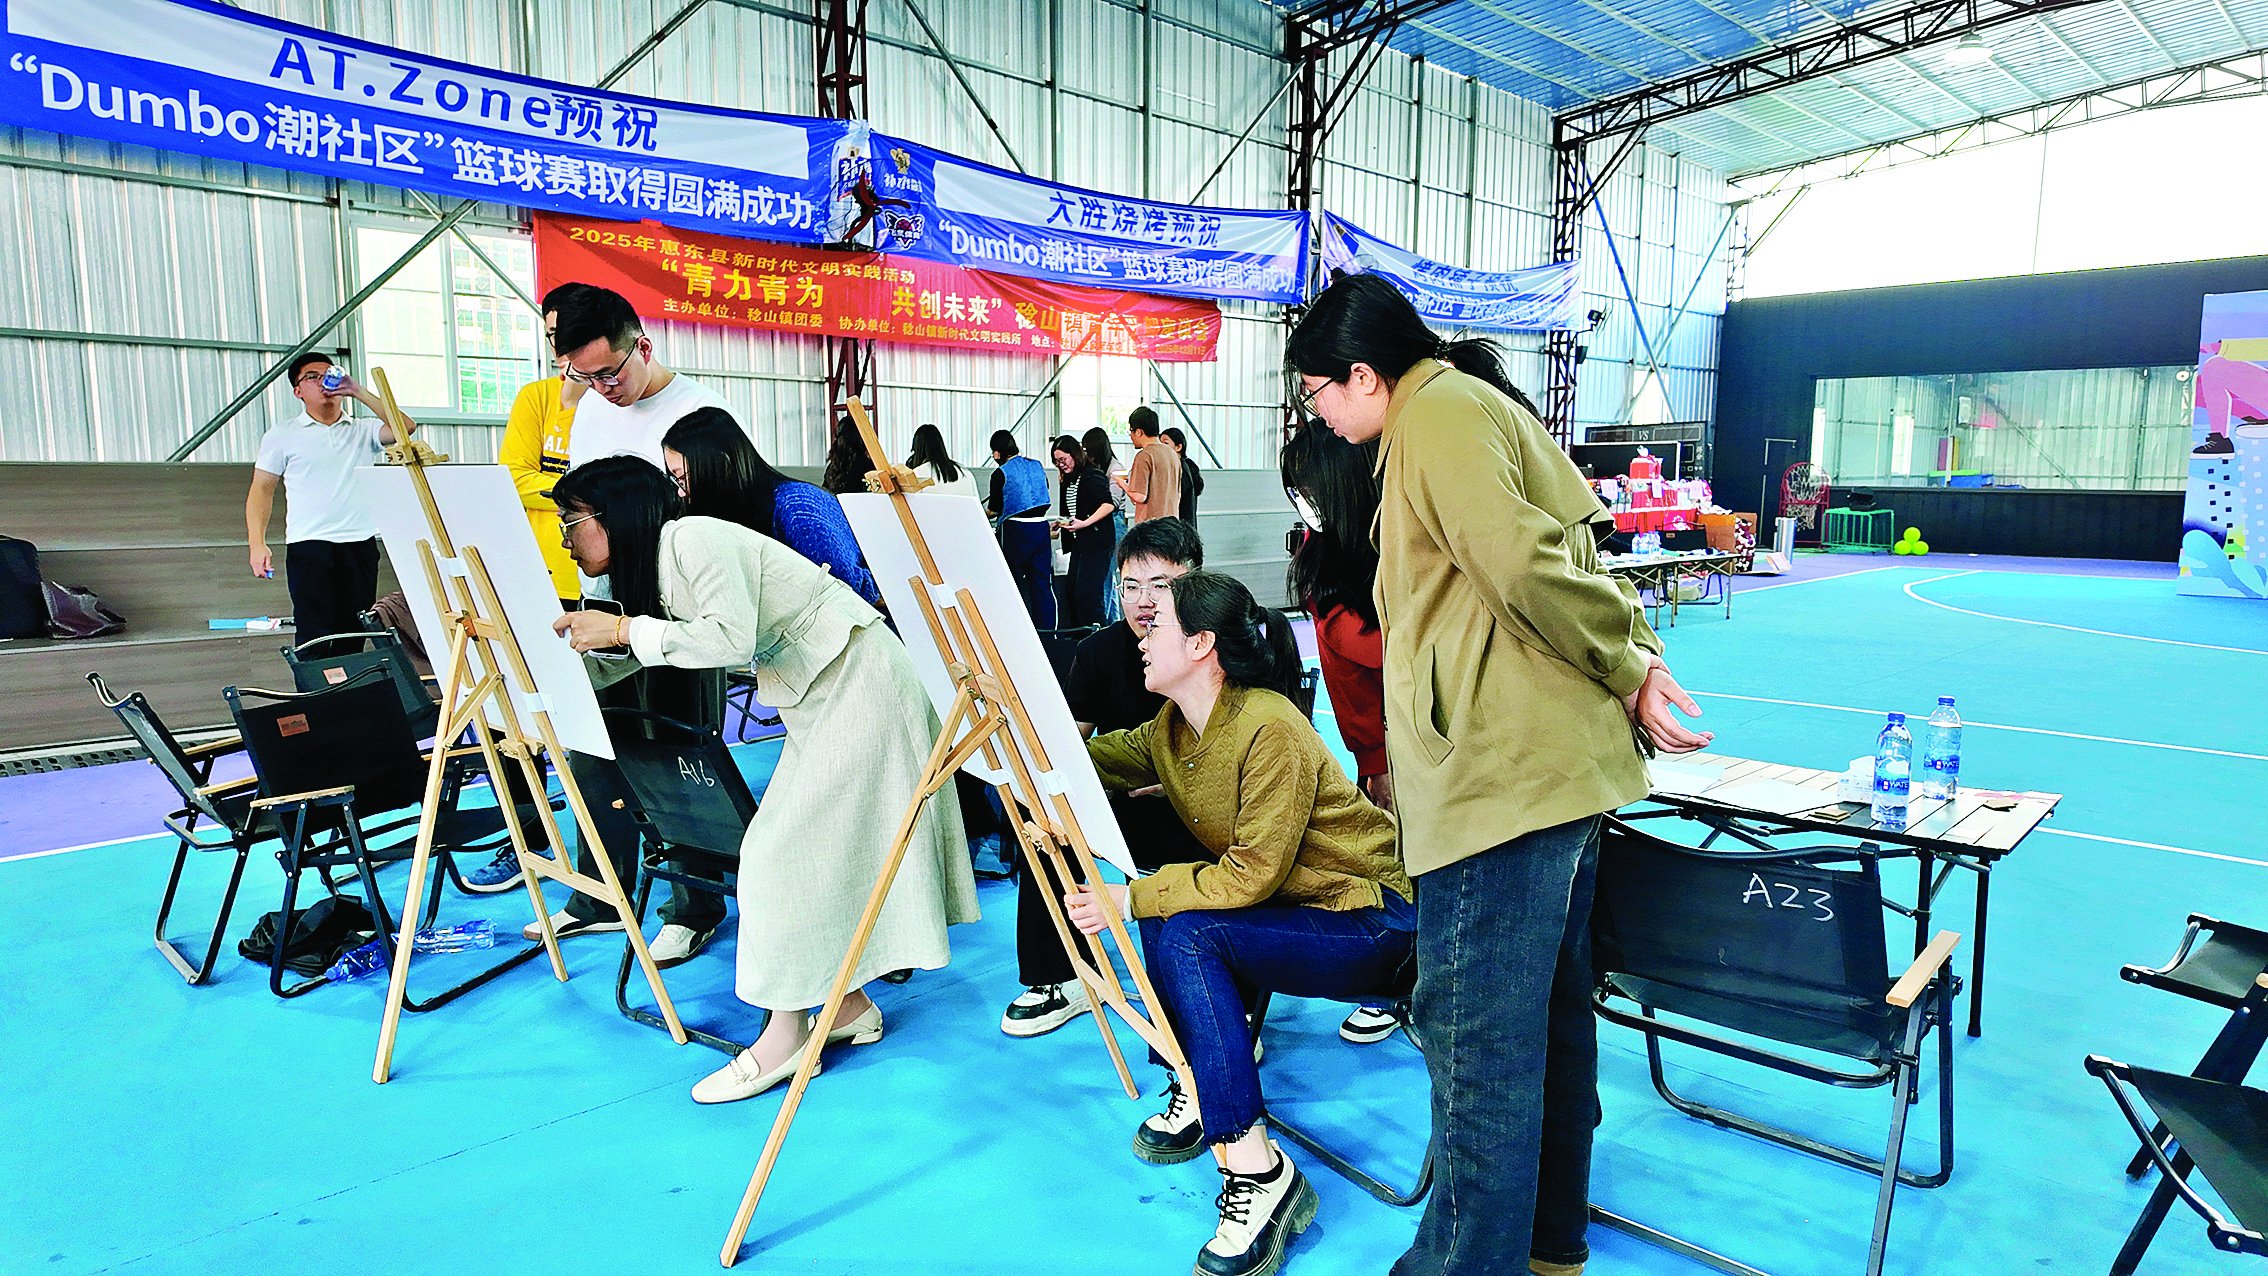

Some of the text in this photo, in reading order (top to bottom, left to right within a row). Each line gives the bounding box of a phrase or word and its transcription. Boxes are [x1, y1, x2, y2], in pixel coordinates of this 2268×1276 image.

[269, 37, 658, 152] AT.Zone预祝
[1046, 190, 1222, 248] 大胜烧烤预祝
[570, 227, 916, 284] 2025年惠东县新时代文明实践活动
[1638, 430, 1649, 441] VS
[678, 756, 715, 787] A16
[1742, 872, 1835, 921] A23
